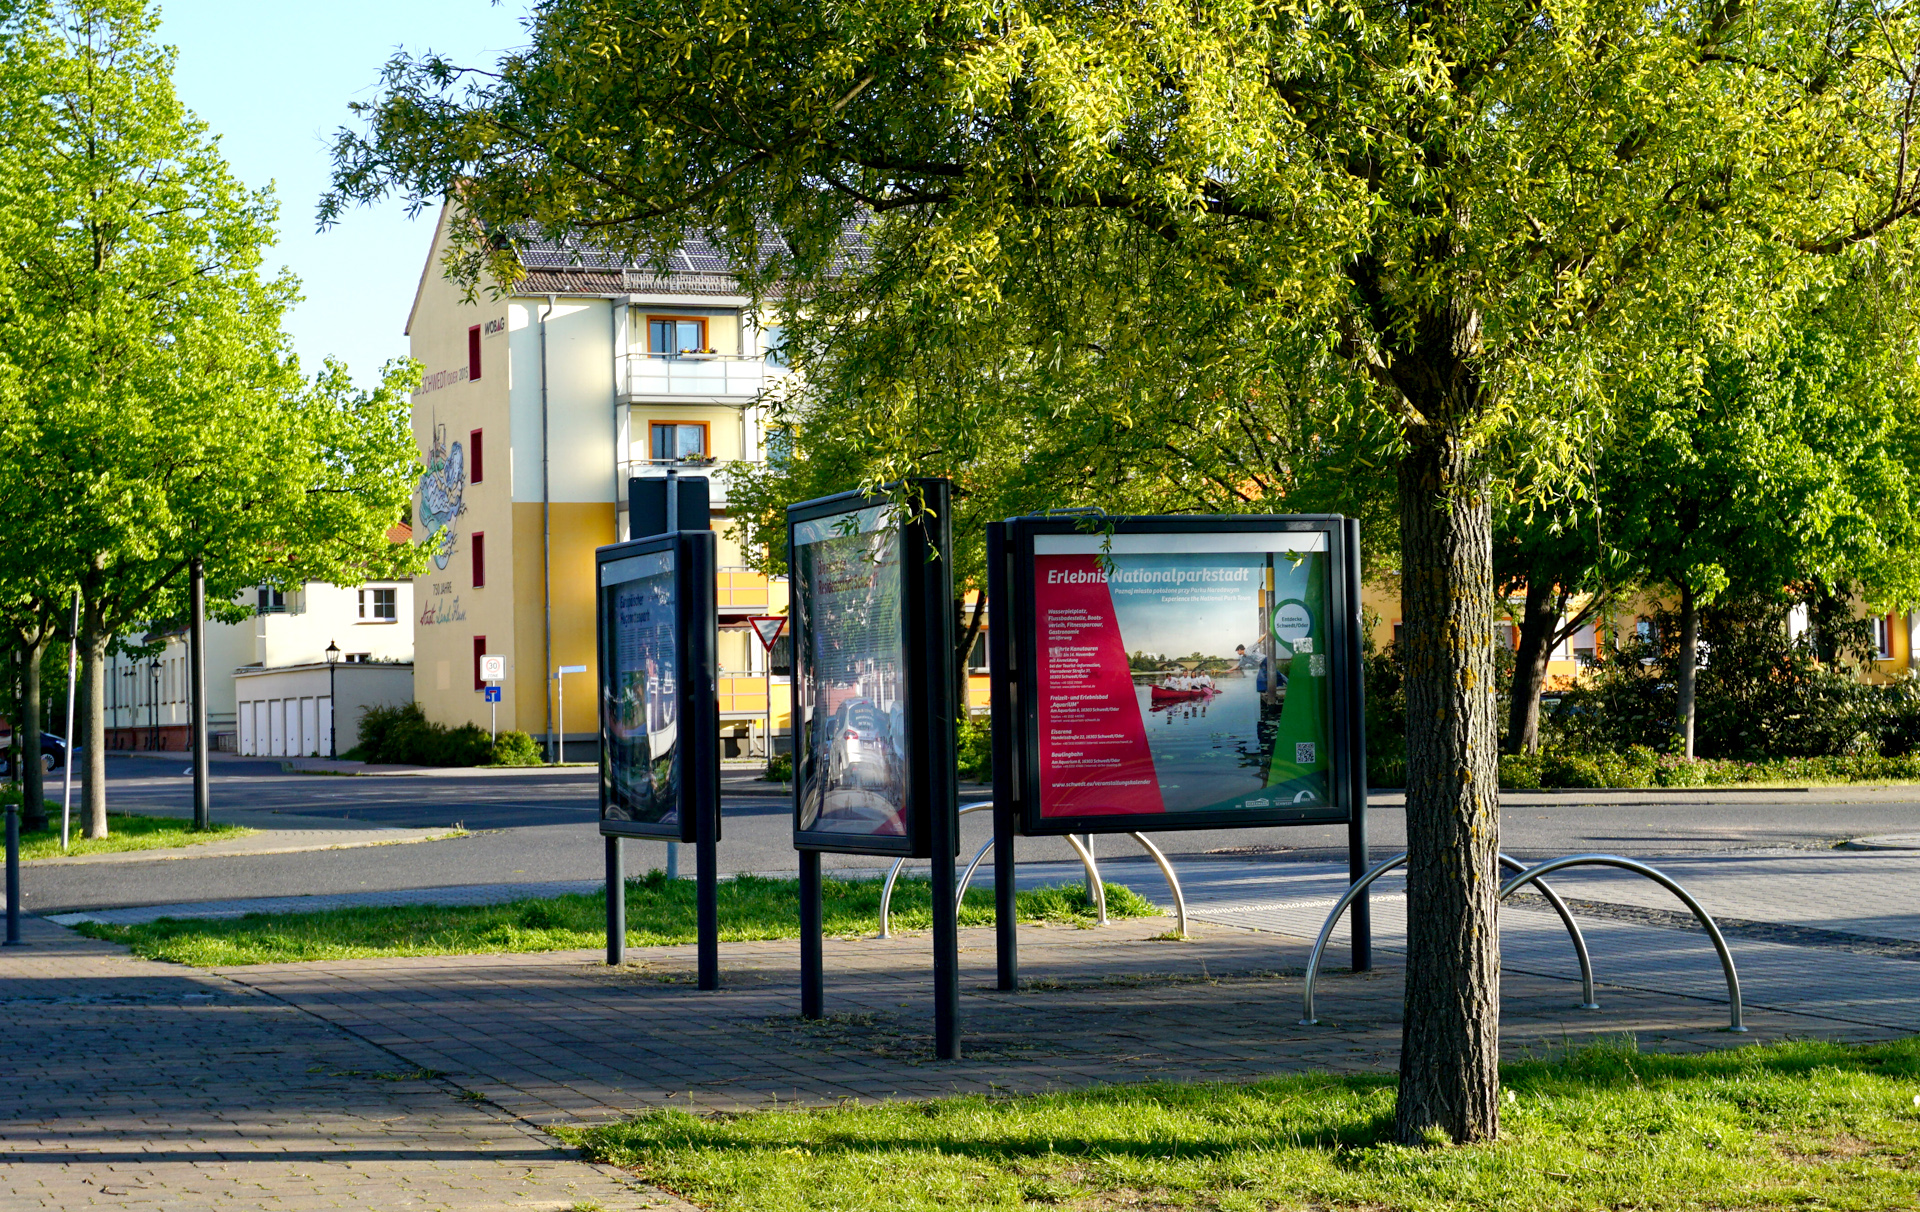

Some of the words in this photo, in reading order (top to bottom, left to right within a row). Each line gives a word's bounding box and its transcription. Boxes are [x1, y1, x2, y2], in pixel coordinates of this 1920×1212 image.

[485, 317, 505, 336] WOBAG
[459, 366, 469, 381] 2015
[1048, 569, 1108, 584] Erlebnis
[1111, 567, 1249, 586] Nationalparkstadt
[440, 581, 452, 595] JAHRE
[488, 662, 497, 670] 30
